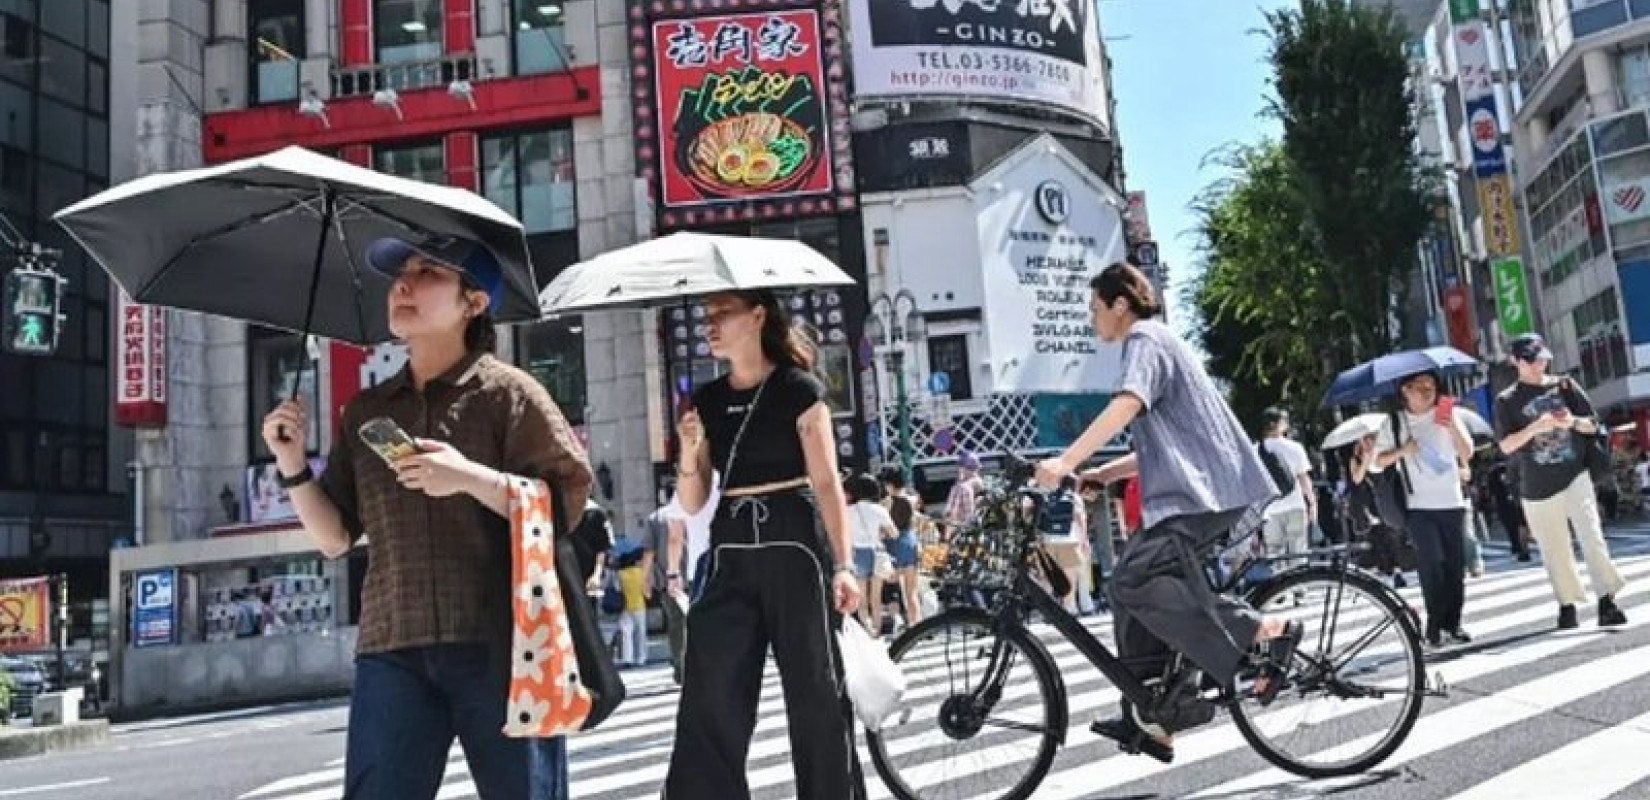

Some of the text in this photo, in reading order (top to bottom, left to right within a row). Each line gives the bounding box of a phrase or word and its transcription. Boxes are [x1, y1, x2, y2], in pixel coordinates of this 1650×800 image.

[1036, 289, 1085, 304] ROLEX
[1499, 268, 1523, 323] レイク
[1034, 339, 1097, 354] CHANEL
[141, 579, 158, 606] P
